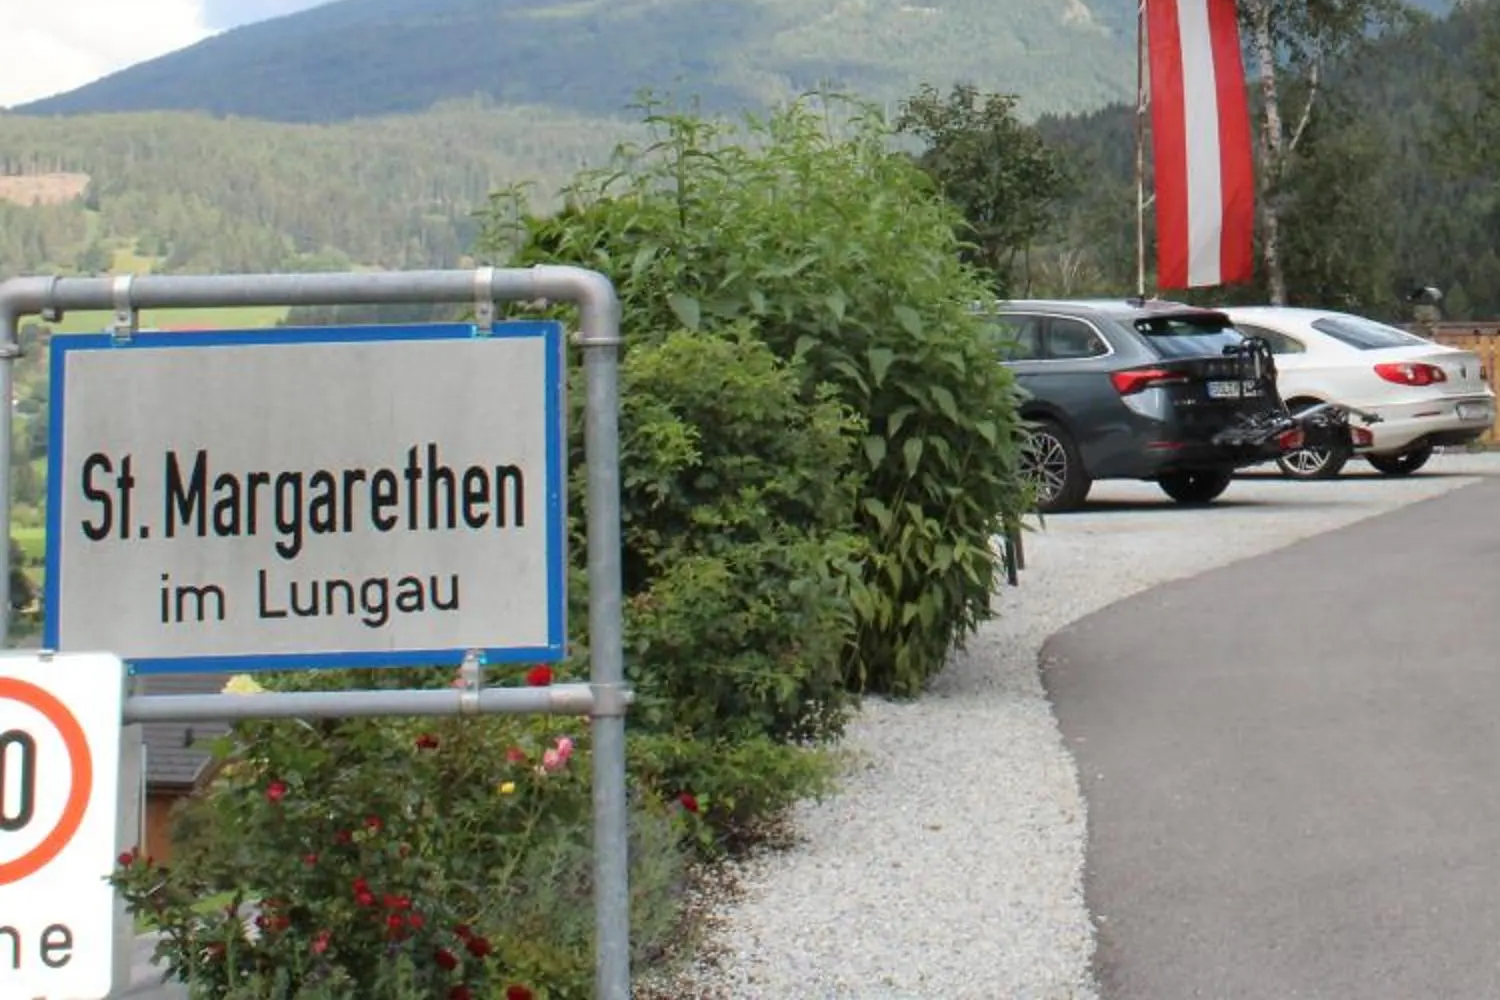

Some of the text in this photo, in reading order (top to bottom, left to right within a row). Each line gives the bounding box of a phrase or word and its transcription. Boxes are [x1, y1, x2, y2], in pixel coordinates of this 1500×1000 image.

[82, 442, 525, 560] St. Margarethen
[161, 569, 459, 629] im Lungau
